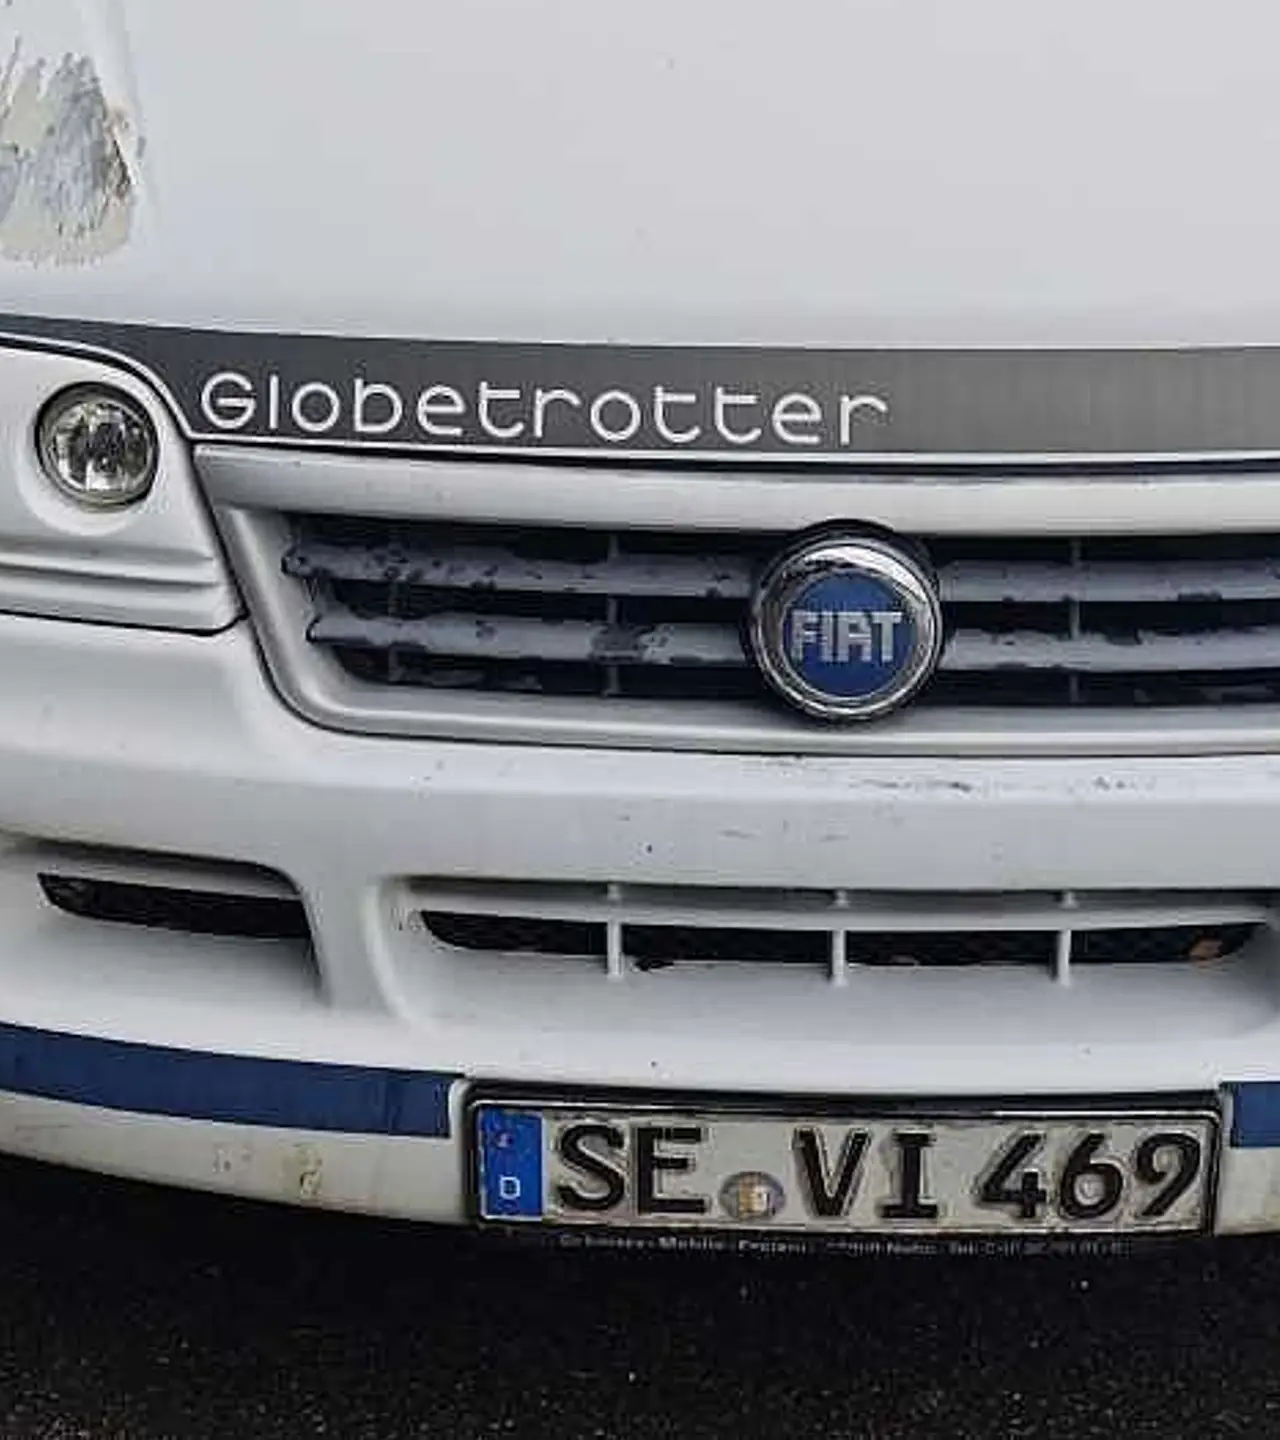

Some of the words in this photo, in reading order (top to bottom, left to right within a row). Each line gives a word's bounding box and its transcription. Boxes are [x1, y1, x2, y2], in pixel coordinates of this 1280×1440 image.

[200, 372, 889, 444] Globetrotter
[791, 611, 902, 663] FIAT
[500, 1175, 520, 1199] D
[559, 1124, 707, 1214] SE
[793, 1127, 937, 1218] VI
[978, 1132, 1200, 1220] 469
